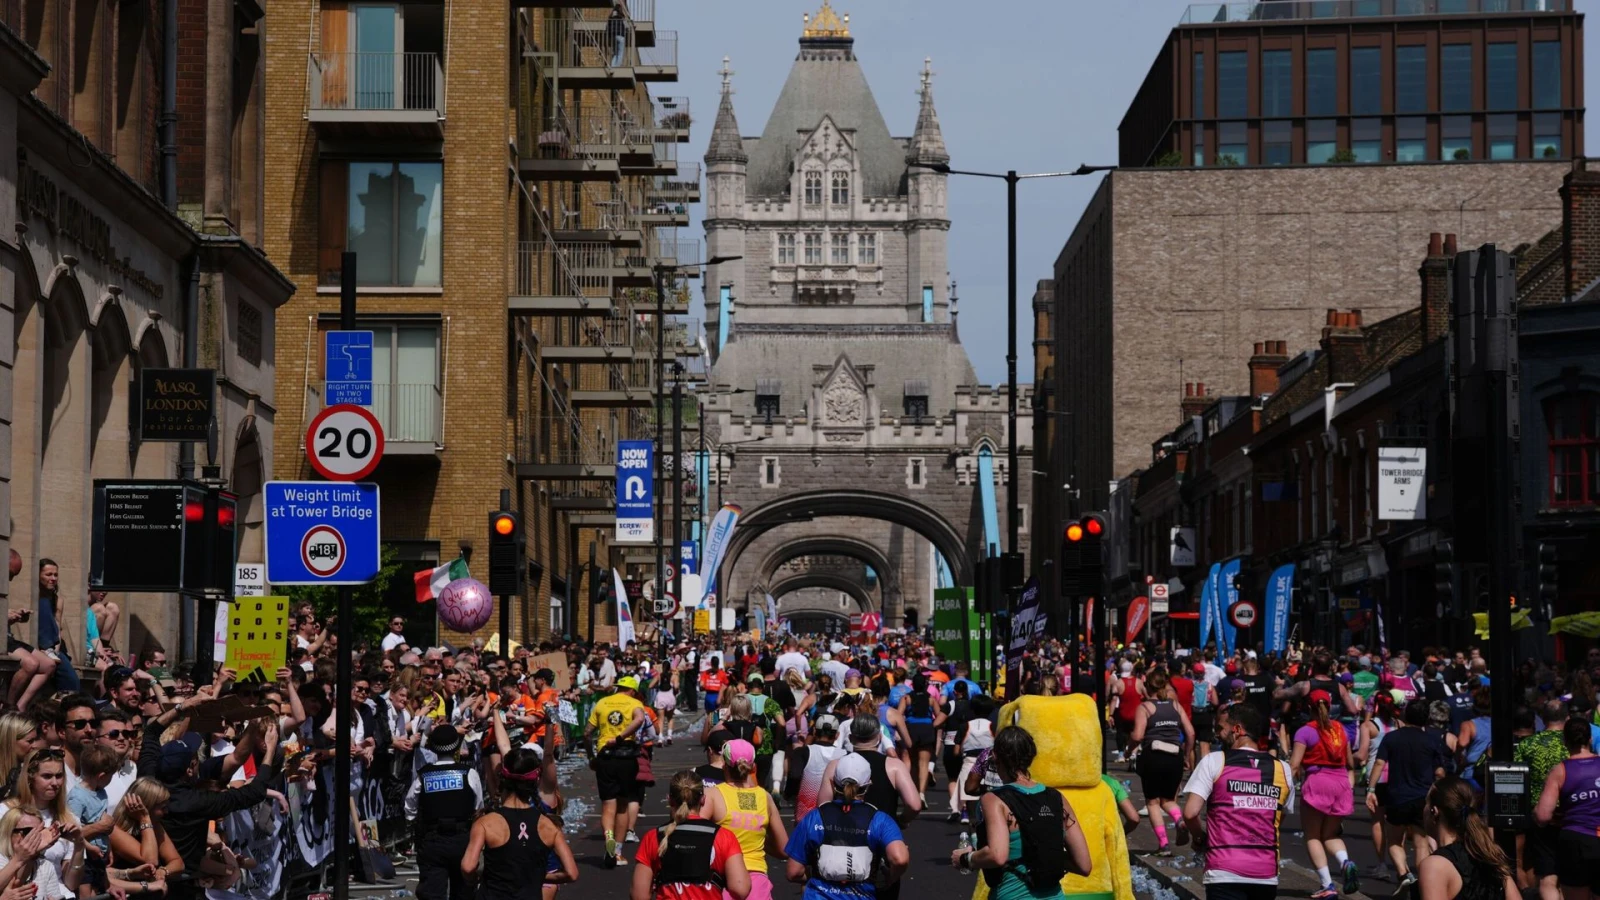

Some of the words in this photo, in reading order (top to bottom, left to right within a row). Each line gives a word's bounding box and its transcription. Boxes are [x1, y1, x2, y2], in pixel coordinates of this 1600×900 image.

[154, 378, 200, 395] MASQ
[145, 399, 209, 411] LONDON
[160, 413, 180, 422] bar
[145, 423, 208, 431] restaurant
[318, 427, 372, 459] 20
[621, 449, 647, 459] NOW
[621, 459, 648, 469] OPEN
[1381, 468, 1402, 477] TOWER
[1402, 469, 1424, 477] BRIDGE
[1393, 477, 1411, 485] ARMS
[284, 489, 329, 504] Weight
[332, 490, 361, 502] limit
[271, 507, 285, 517] at
[288, 505, 328, 518] Tower
[332, 506, 373, 520] Bridge
[238, 568, 258, 580] 185
[1276, 576, 1287, 592] UK
[235, 603, 284, 611] YOU
[935, 599, 961, 611] FLORA
[233, 617, 283, 626] GOT
[449, 605, 484, 627] Day
[1273, 595, 1285, 651] DIABETES
[233, 632, 282, 641] THIS
[935, 629, 963, 641] FLORA
[426, 779, 461, 791] POLICE
[1229, 780, 1257, 794] YOUNG
[1258, 784, 1280, 798] LIVES
[1571, 789, 1600, 802] sen
[1246, 797, 1277, 809] CANCER
